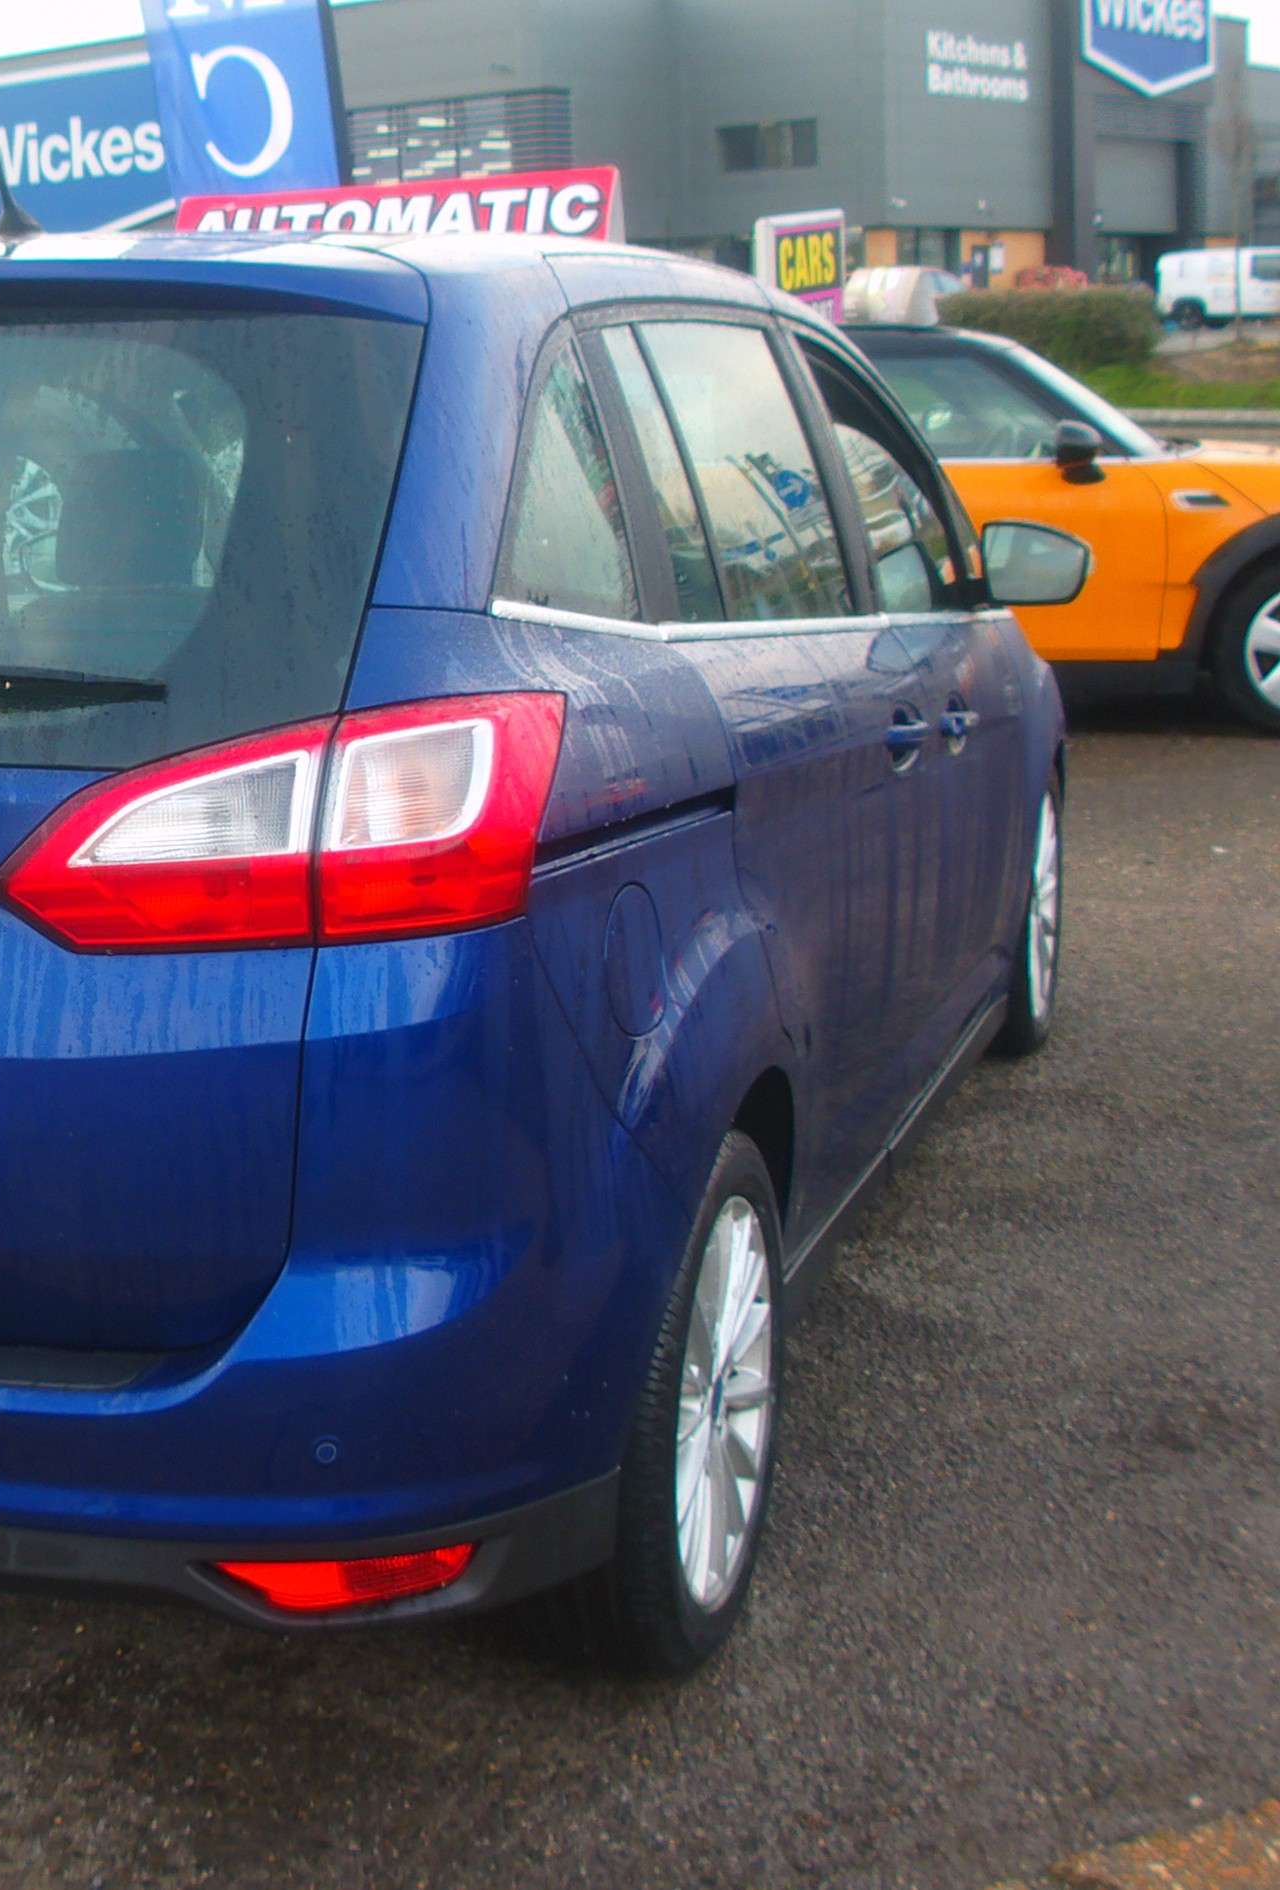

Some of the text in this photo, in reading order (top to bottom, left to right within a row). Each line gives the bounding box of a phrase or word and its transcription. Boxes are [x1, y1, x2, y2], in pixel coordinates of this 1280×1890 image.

[926, 30, 1011, 65] Kitchens
[927, 62, 1028, 100] Bathrooms
[779, 232, 836, 291] CARS
